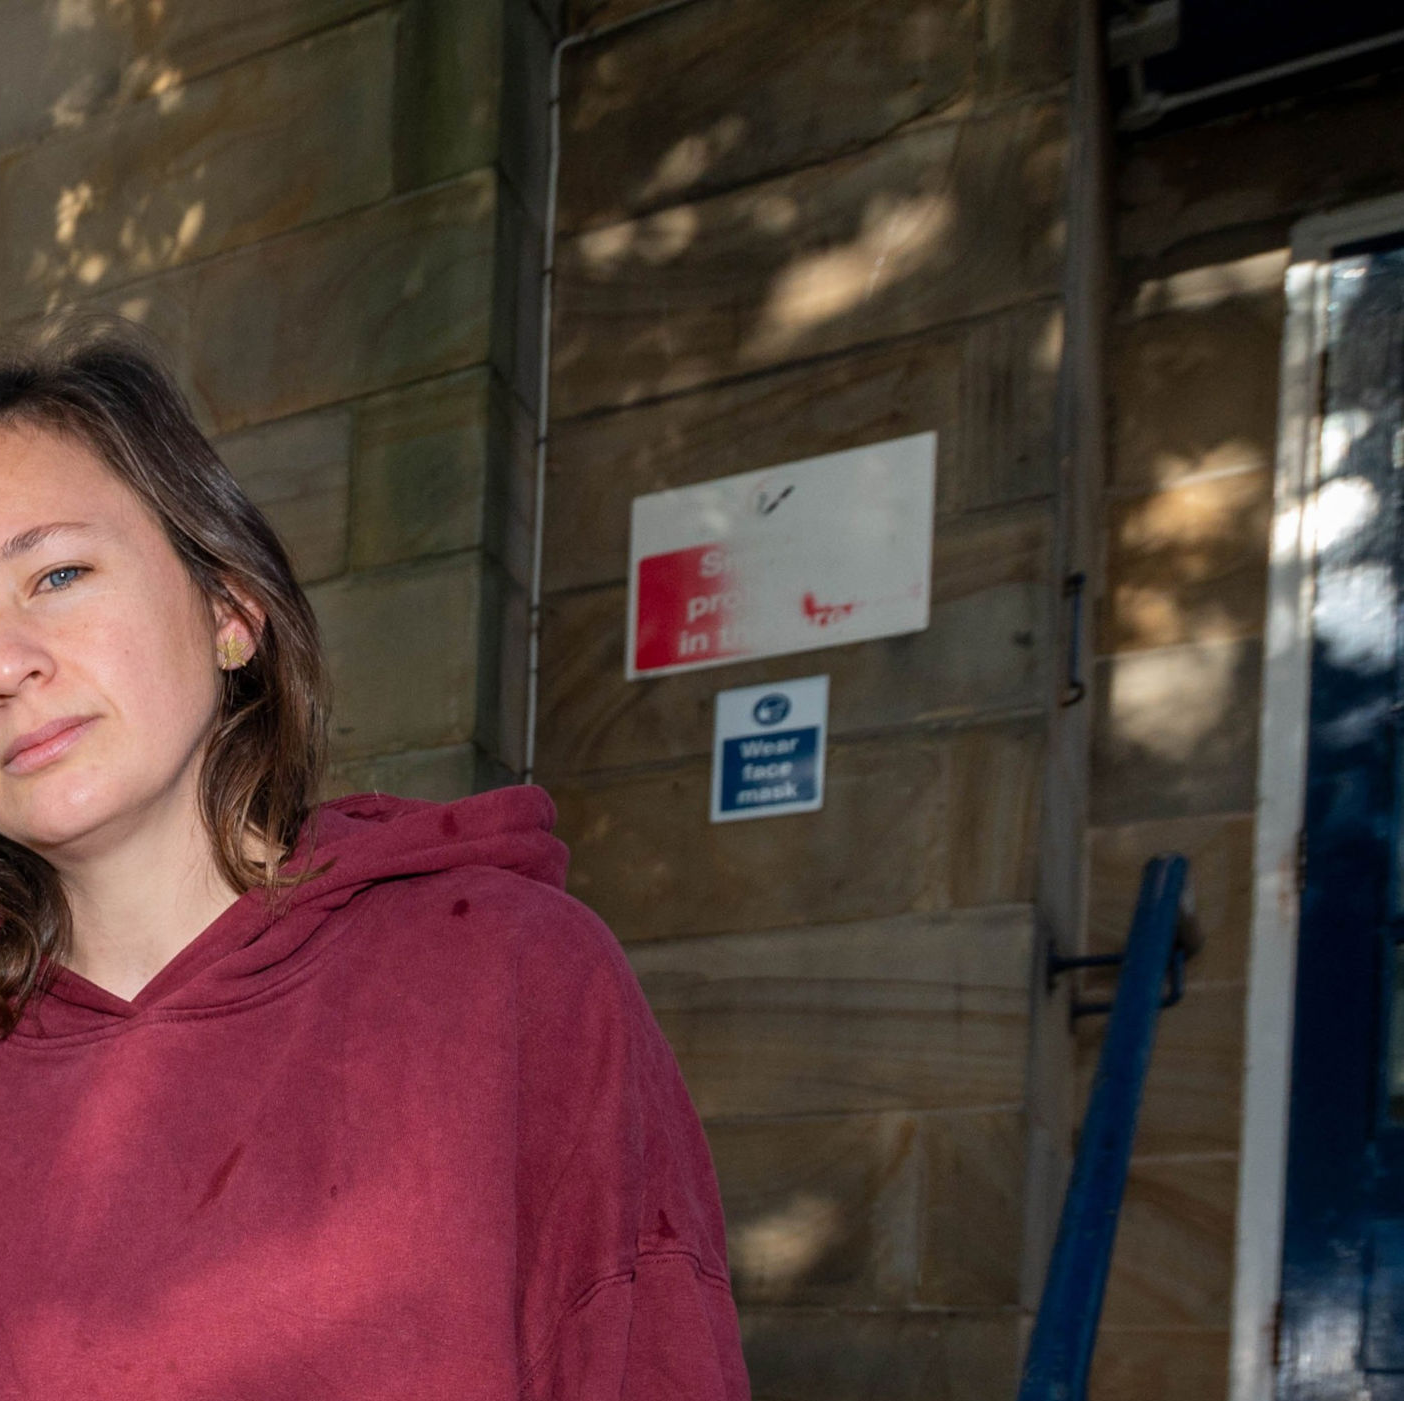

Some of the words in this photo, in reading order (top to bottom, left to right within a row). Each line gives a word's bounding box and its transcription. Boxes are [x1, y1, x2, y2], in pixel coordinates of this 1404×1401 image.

[739, 738, 800, 759] Wear
[742, 763, 793, 782] face
[736, 781, 798, 805] mask
